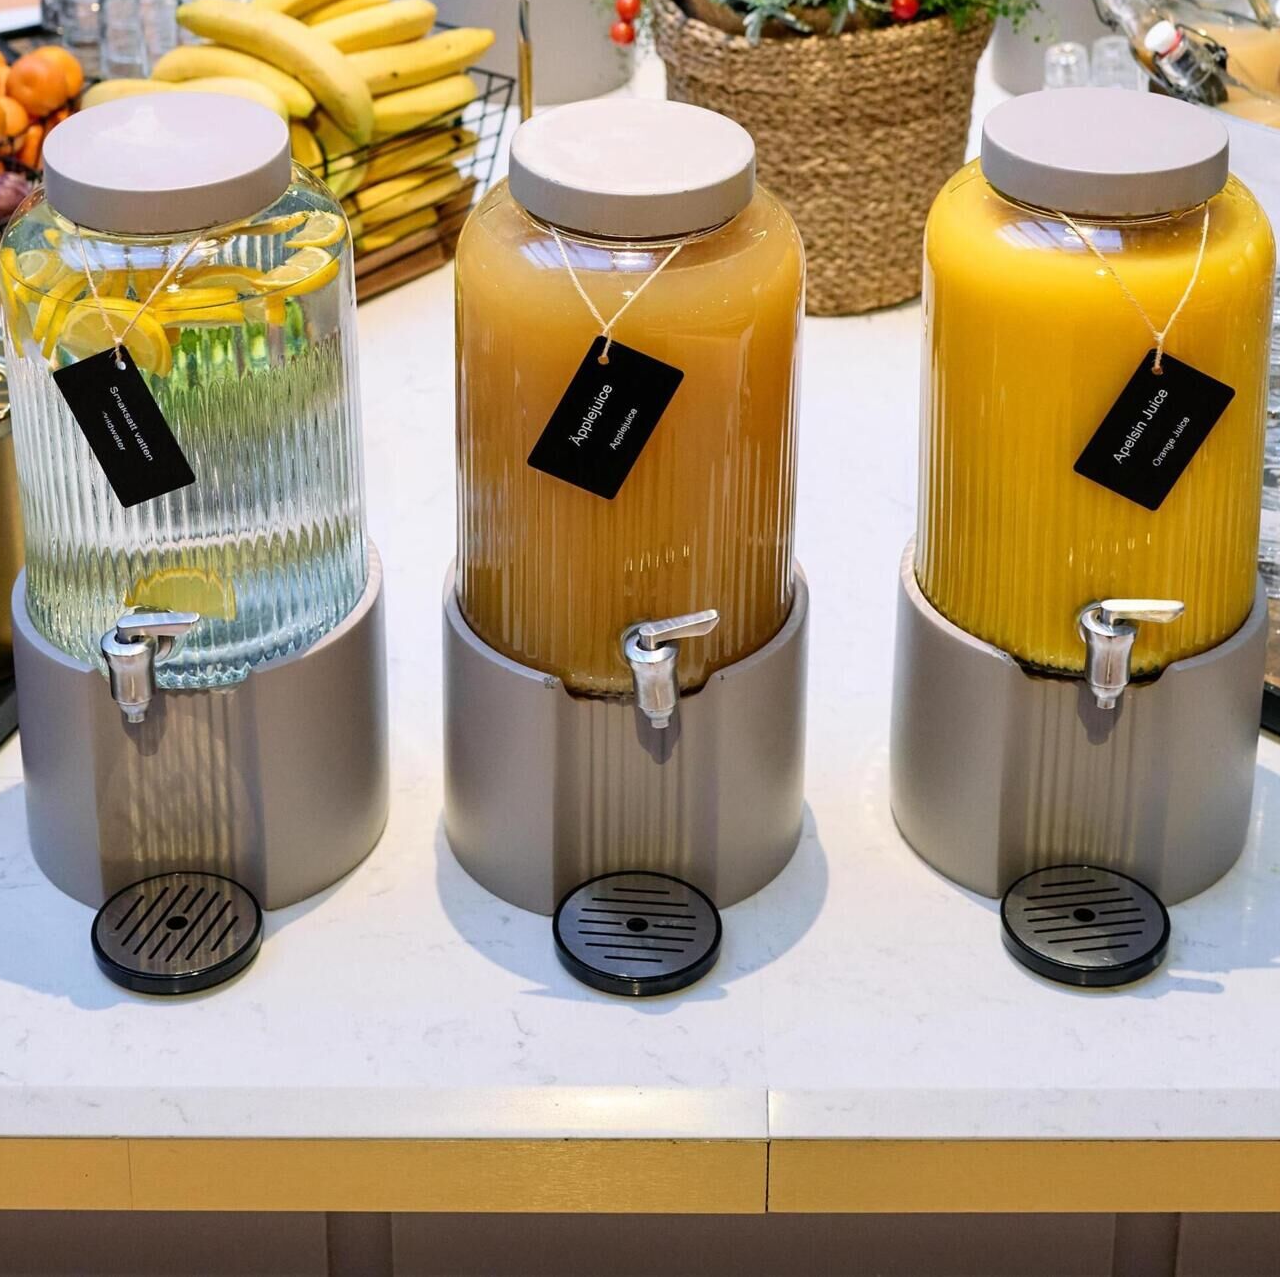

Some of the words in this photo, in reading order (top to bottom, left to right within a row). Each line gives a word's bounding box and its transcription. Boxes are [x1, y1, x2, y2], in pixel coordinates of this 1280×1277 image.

[109, 386, 139, 434] Smaksatt
[134, 432, 154, 461] vatten
[568, 384, 613, 447] Äpplejuice
[609, 408, 638, 451] Applejuice
[1113, 421, 1148, 465] Apelsin
[1142, 389, 1169, 421] Juice
[1152, 438, 1176, 467] Orange
[1172, 416, 1190, 438] Juice
